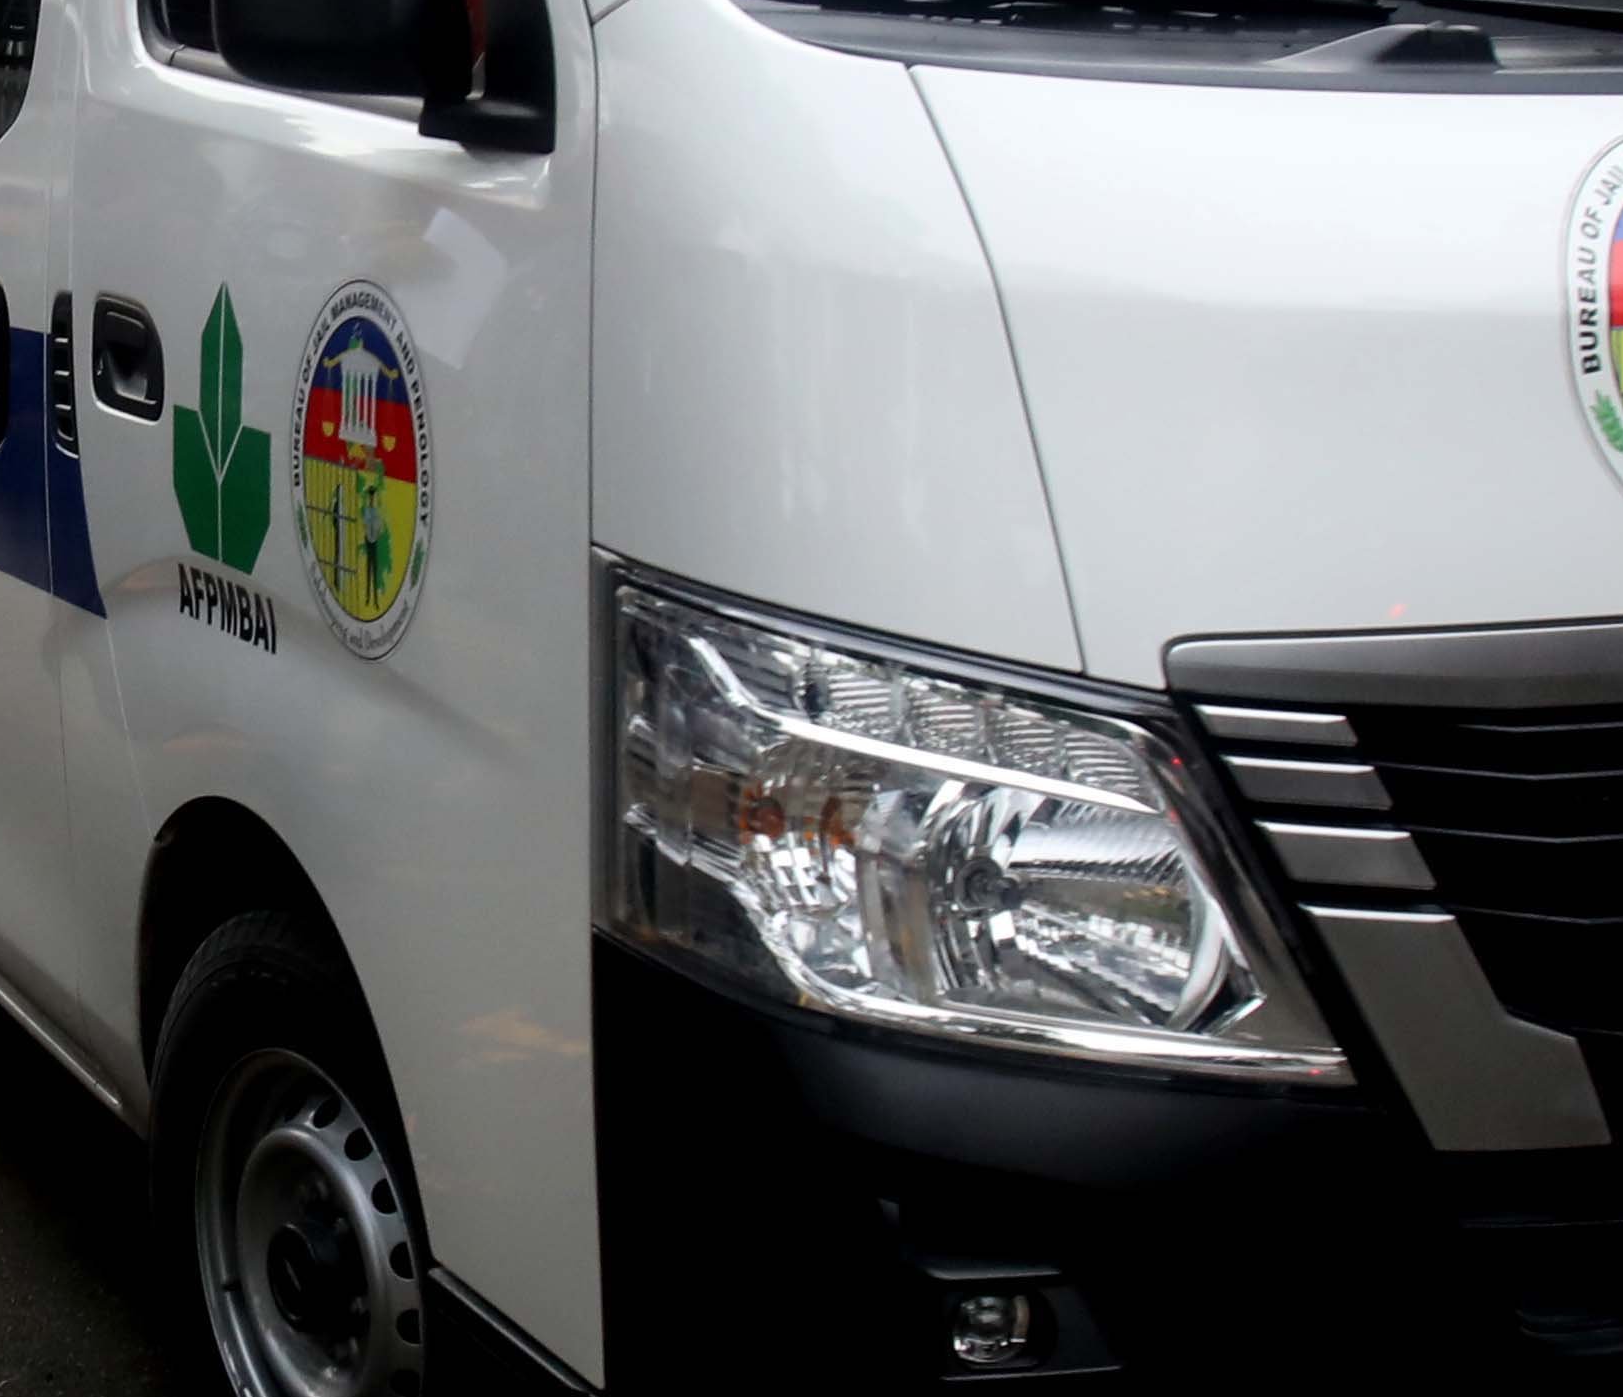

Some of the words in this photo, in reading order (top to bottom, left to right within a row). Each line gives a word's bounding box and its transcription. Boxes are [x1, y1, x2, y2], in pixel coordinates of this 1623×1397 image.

[1580, 206, 1603, 241] OF
[1577, 245, 1602, 375] BUREAU
[178, 563, 277, 655] AFPMBAI
